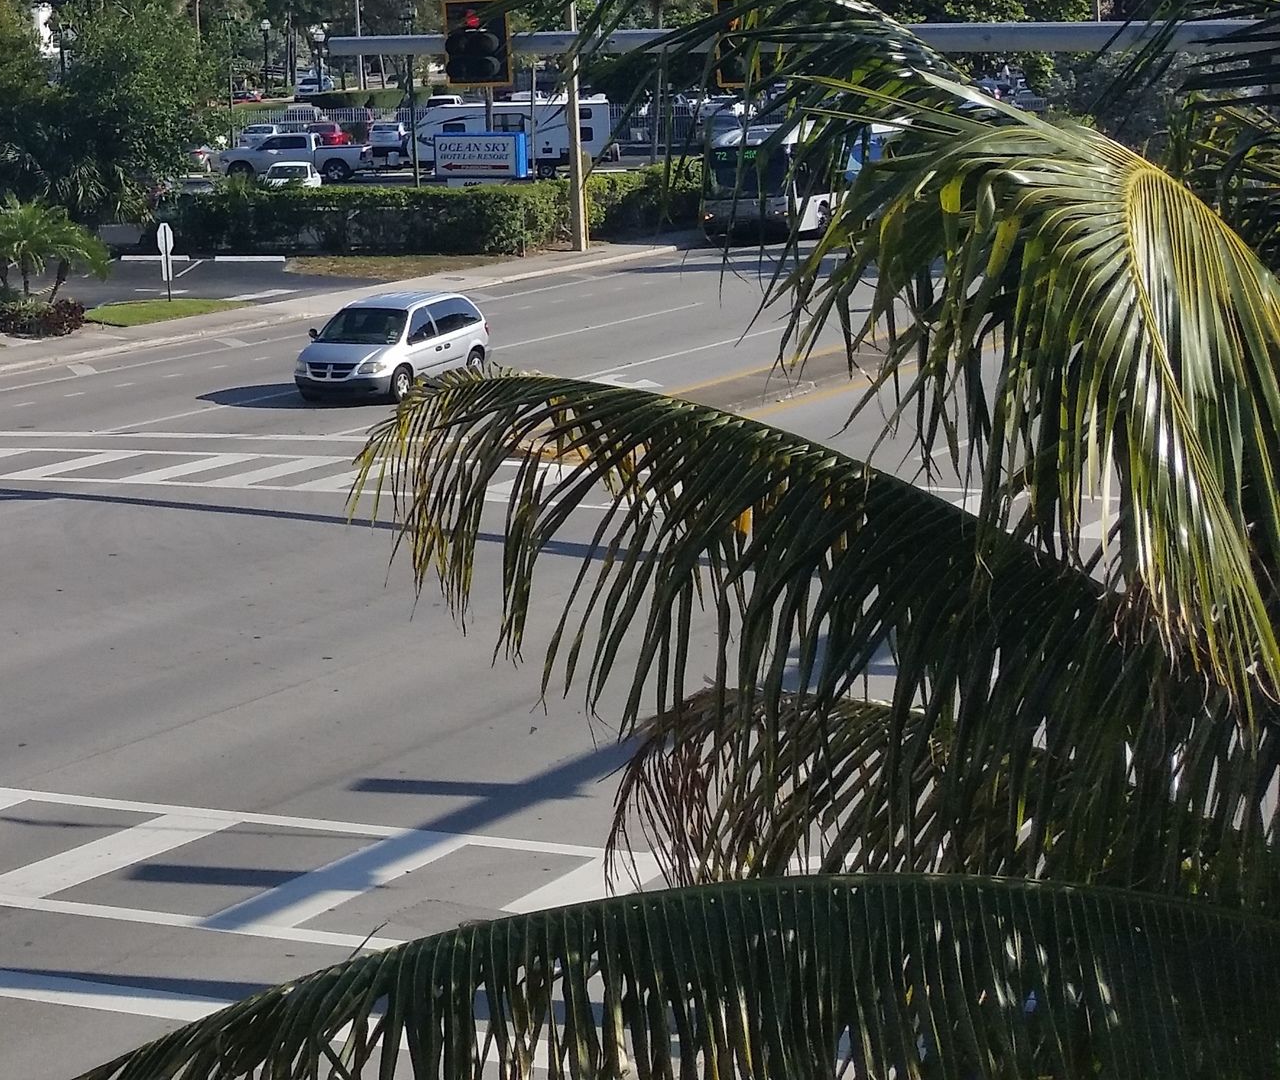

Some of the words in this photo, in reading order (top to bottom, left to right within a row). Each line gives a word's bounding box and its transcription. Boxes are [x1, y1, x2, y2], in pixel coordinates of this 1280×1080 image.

[439, 142, 481, 152] OCEAN
[484, 142, 509, 152] SKY
[715, 151, 727, 160] 72
